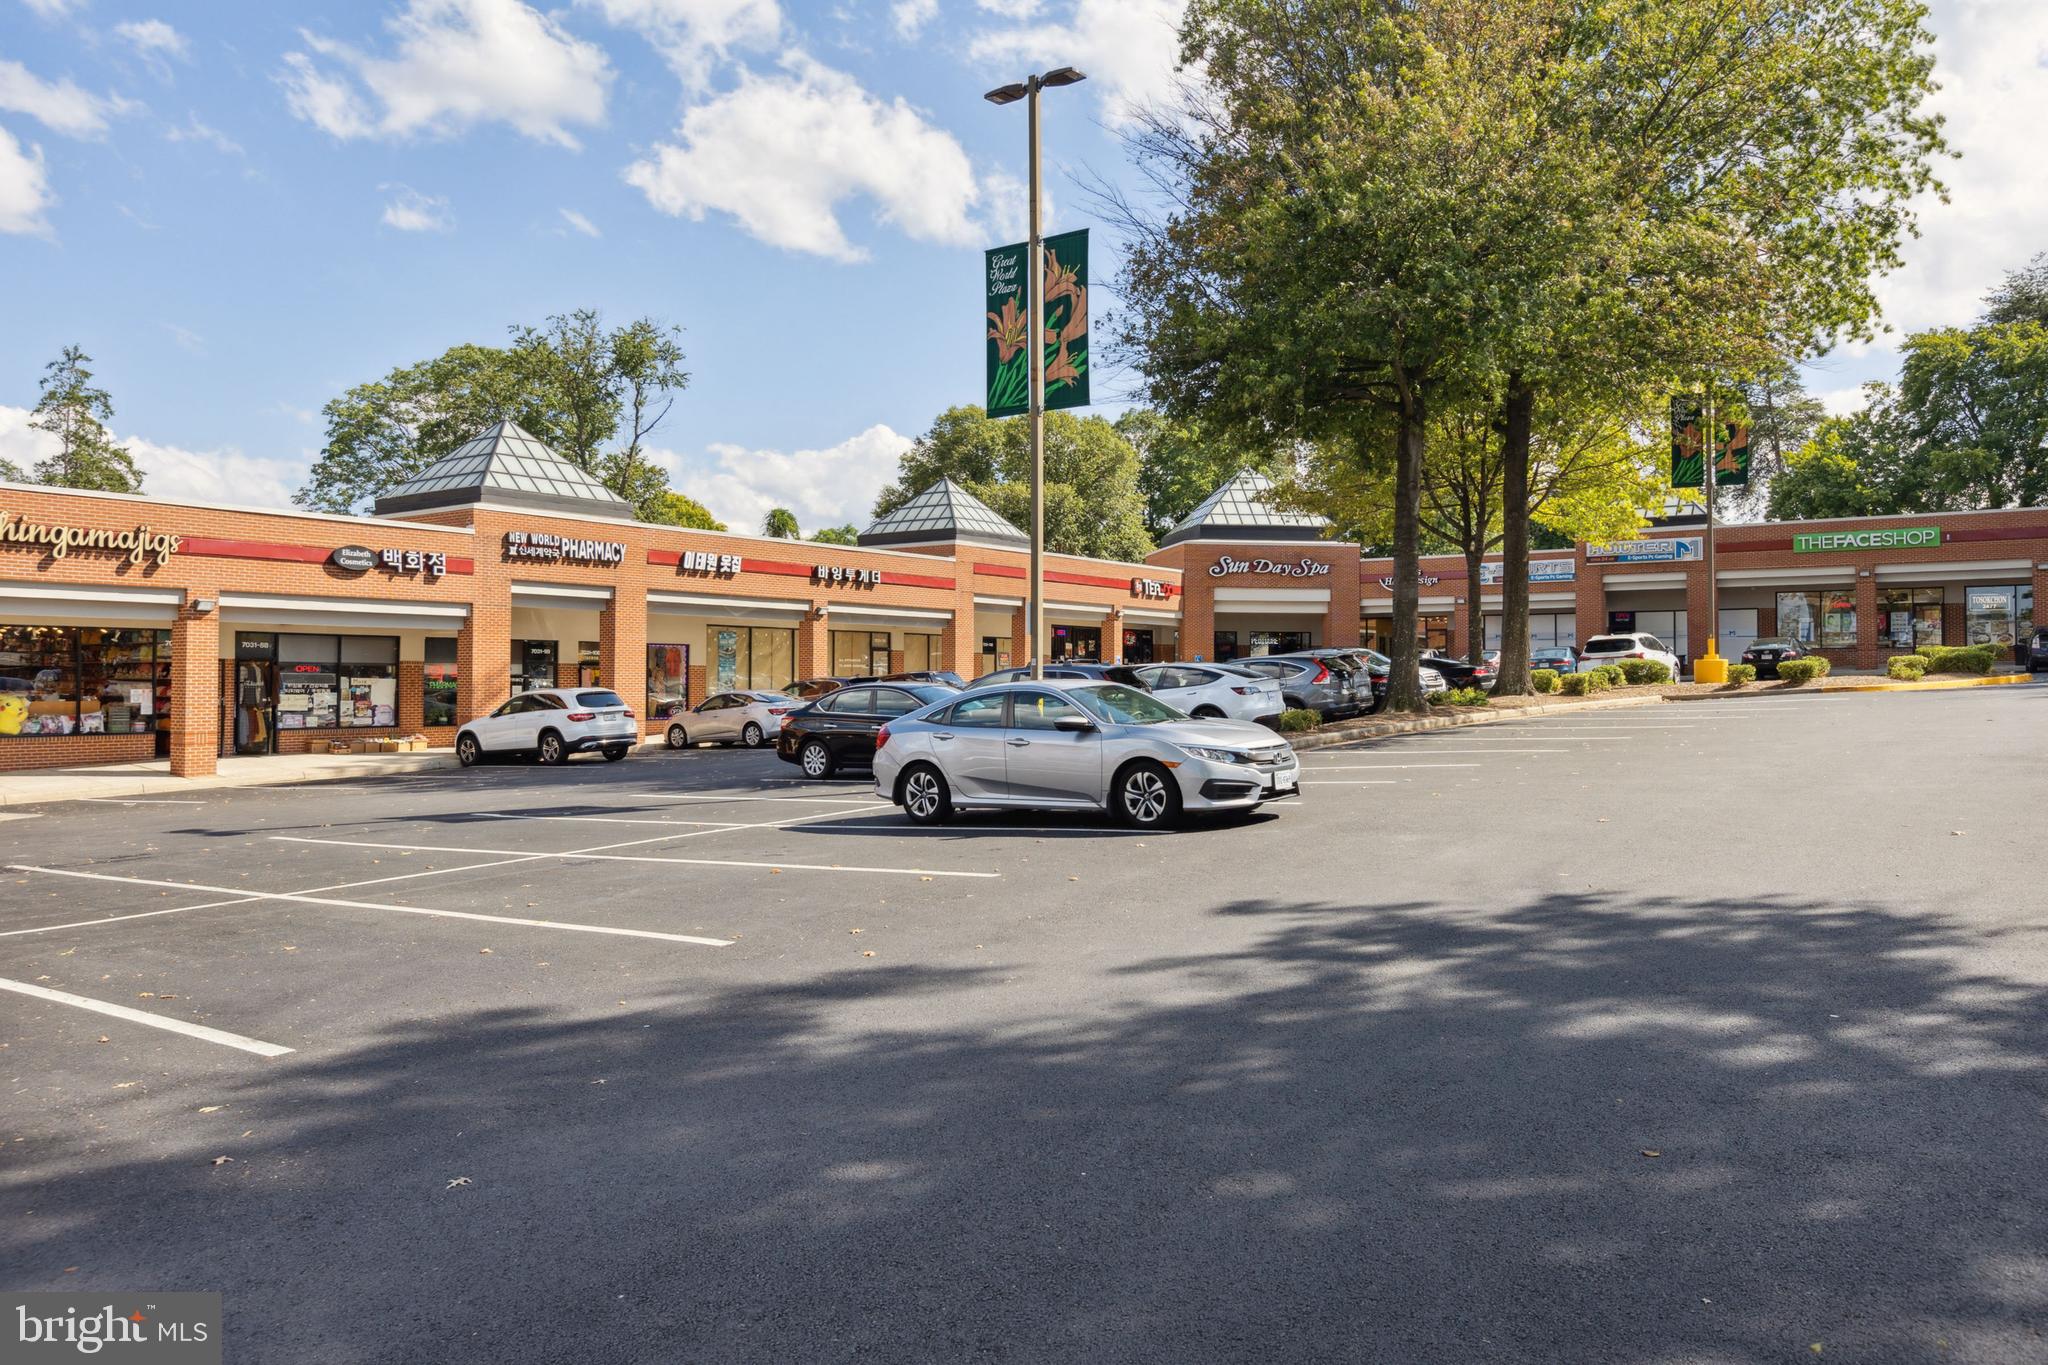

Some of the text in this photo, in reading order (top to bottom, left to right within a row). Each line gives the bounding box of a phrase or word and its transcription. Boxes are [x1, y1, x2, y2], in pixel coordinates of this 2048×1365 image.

[992, 254, 1017, 269] Great
[990, 266, 1019, 282] World
[989, 280, 1018, 296] Plaza
[0, 510, 184, 565] hingamajigs
[508, 531, 560, 547] NEW WORLD
[342, 549, 371, 558] Elizabeth
[561, 537, 627, 563] PHARMACY
[340, 557, 373, 567] Cosmetics
[383, 548, 446, 576] 백화점
[683, 551, 717, 571] 이태원
[1209, 556, 1329, 577] Sun Day Spa
[295, 665, 319, 673] OPEN
[430, 681, 457, 689] PHARMA
